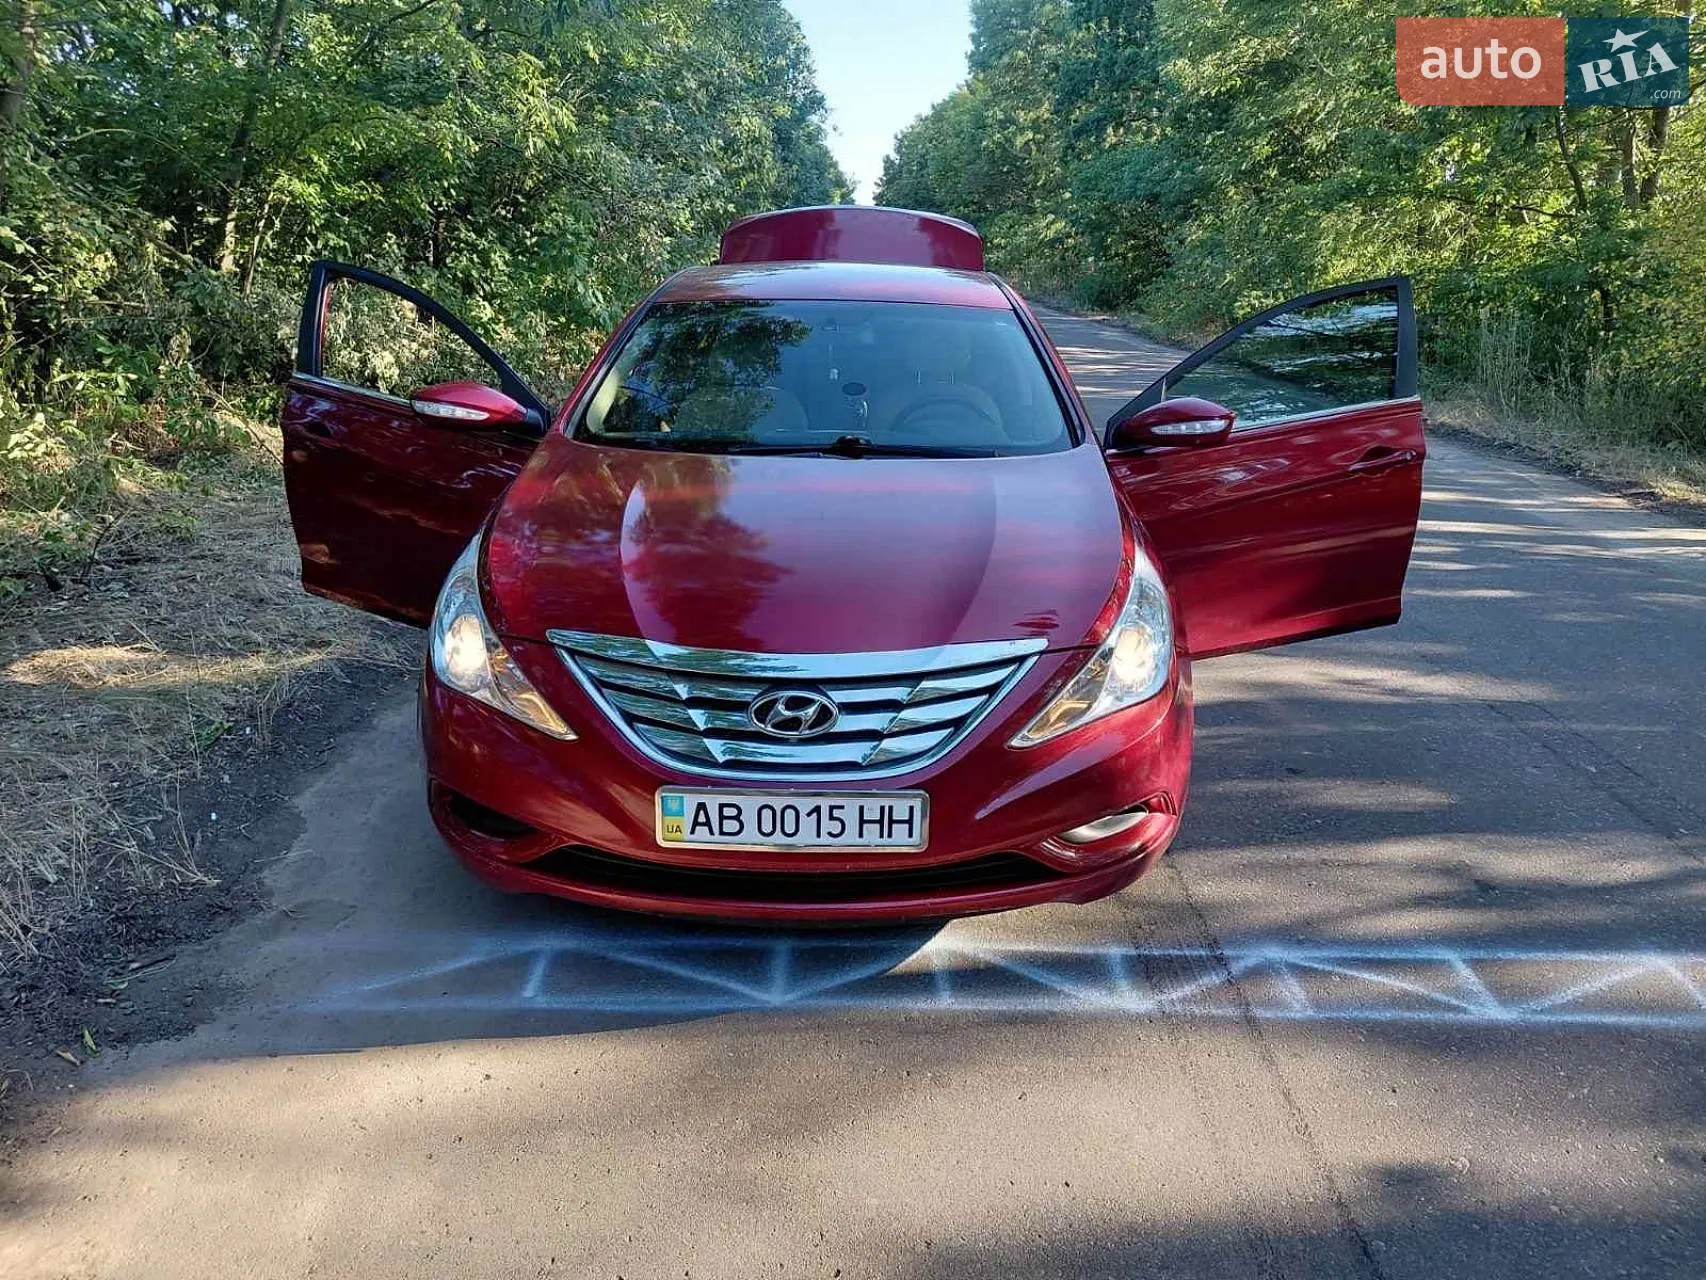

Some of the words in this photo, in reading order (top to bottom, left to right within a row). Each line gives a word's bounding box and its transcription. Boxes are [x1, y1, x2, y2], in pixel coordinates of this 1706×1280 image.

[666, 824, 683, 834] UA
[689, 801, 745, 837] AB
[756, 803, 846, 839] 0015
[858, 804, 913, 839] HH
